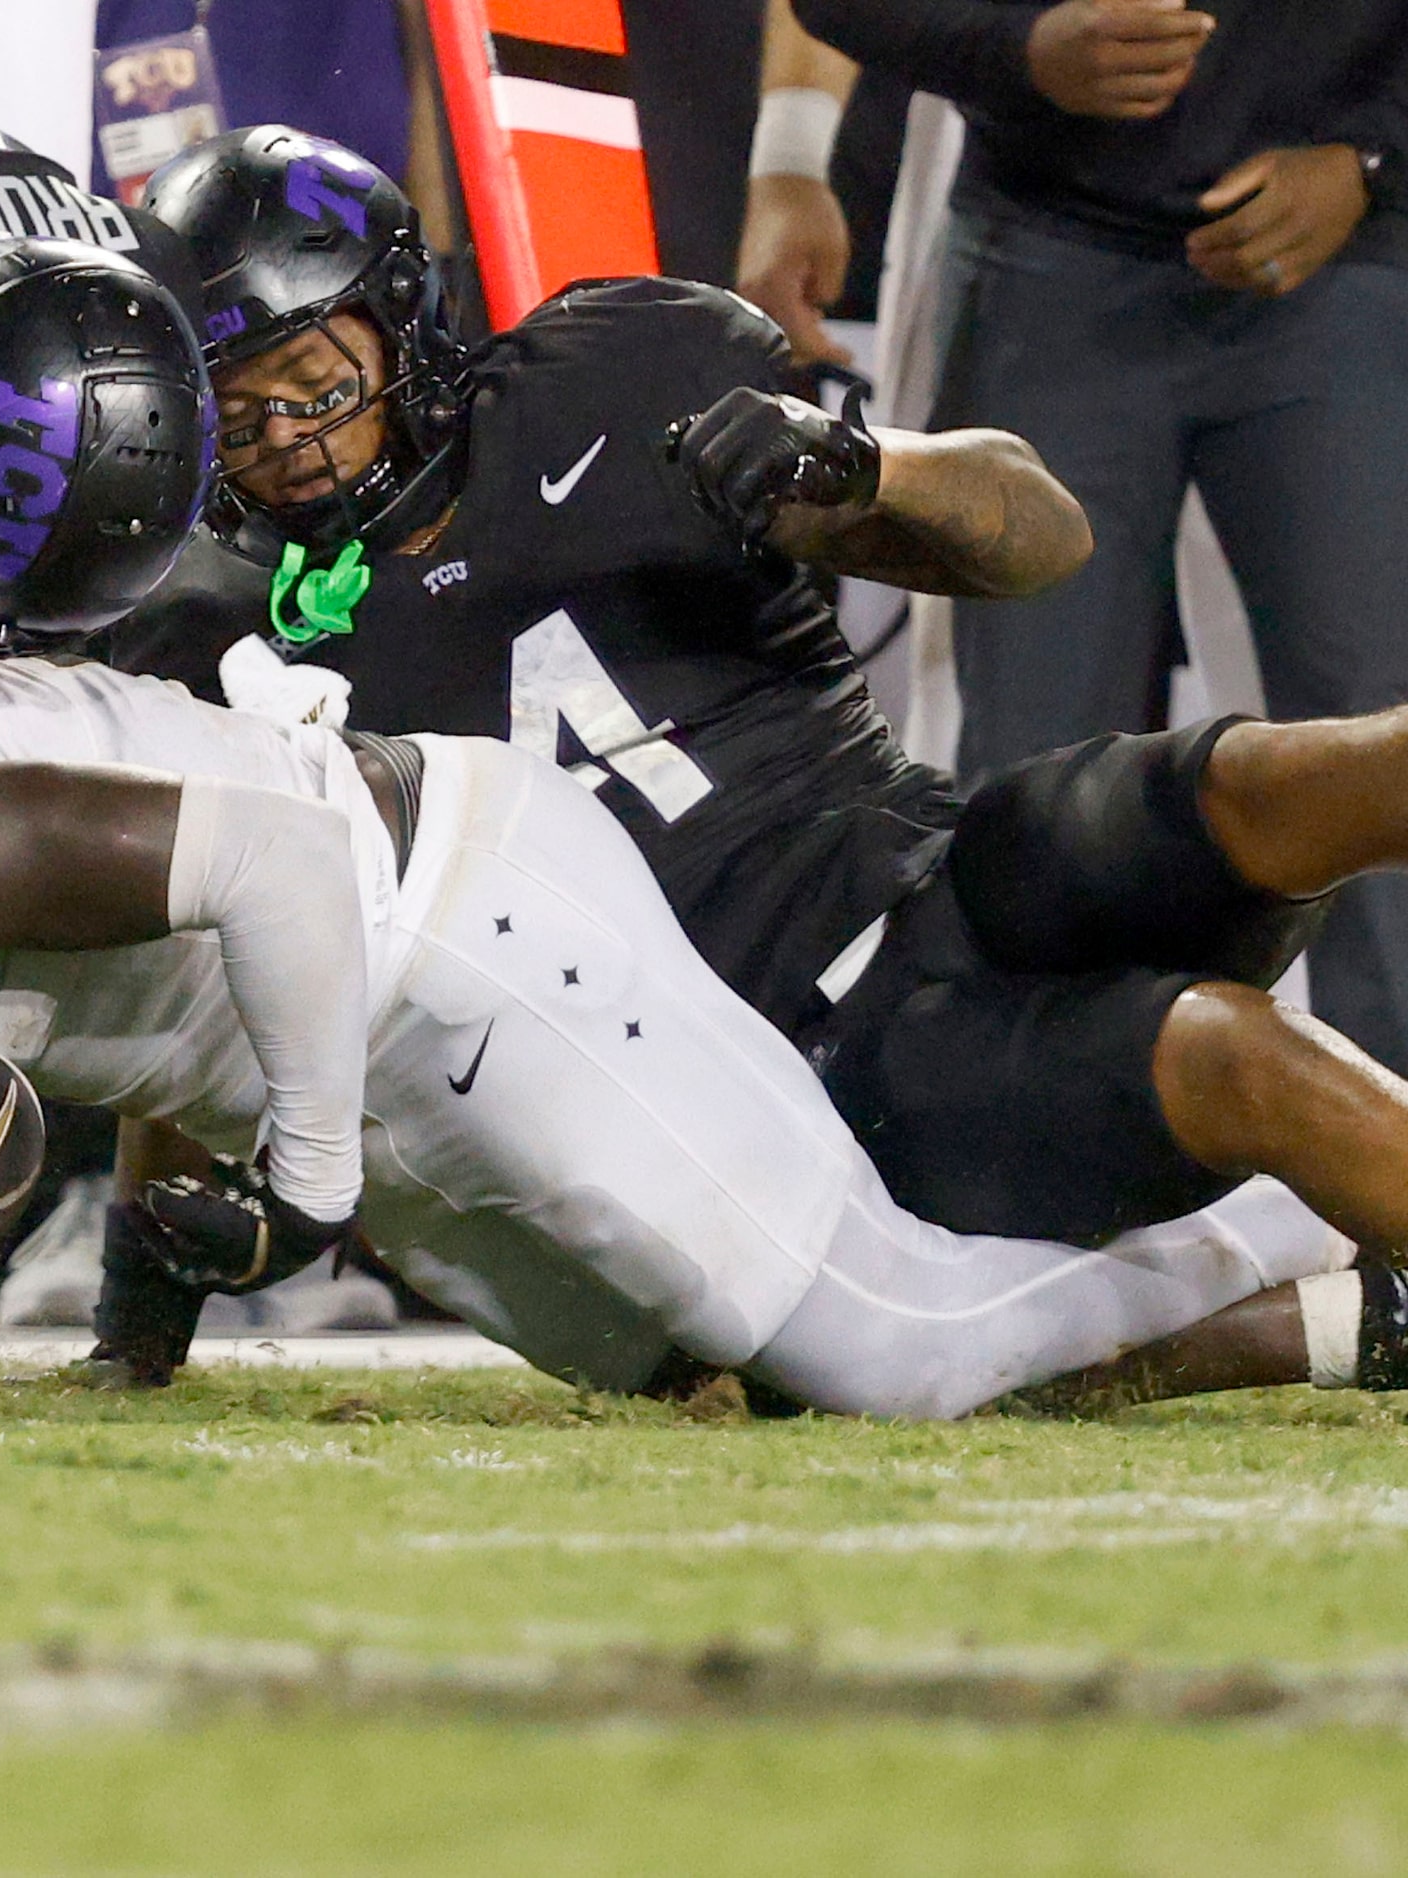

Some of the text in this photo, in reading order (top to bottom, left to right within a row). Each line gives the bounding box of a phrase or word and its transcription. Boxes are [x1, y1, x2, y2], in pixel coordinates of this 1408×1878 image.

[103, 48, 197, 106] TCU
[422, 560, 469, 597] TCU
[509, 607, 715, 824] 4
